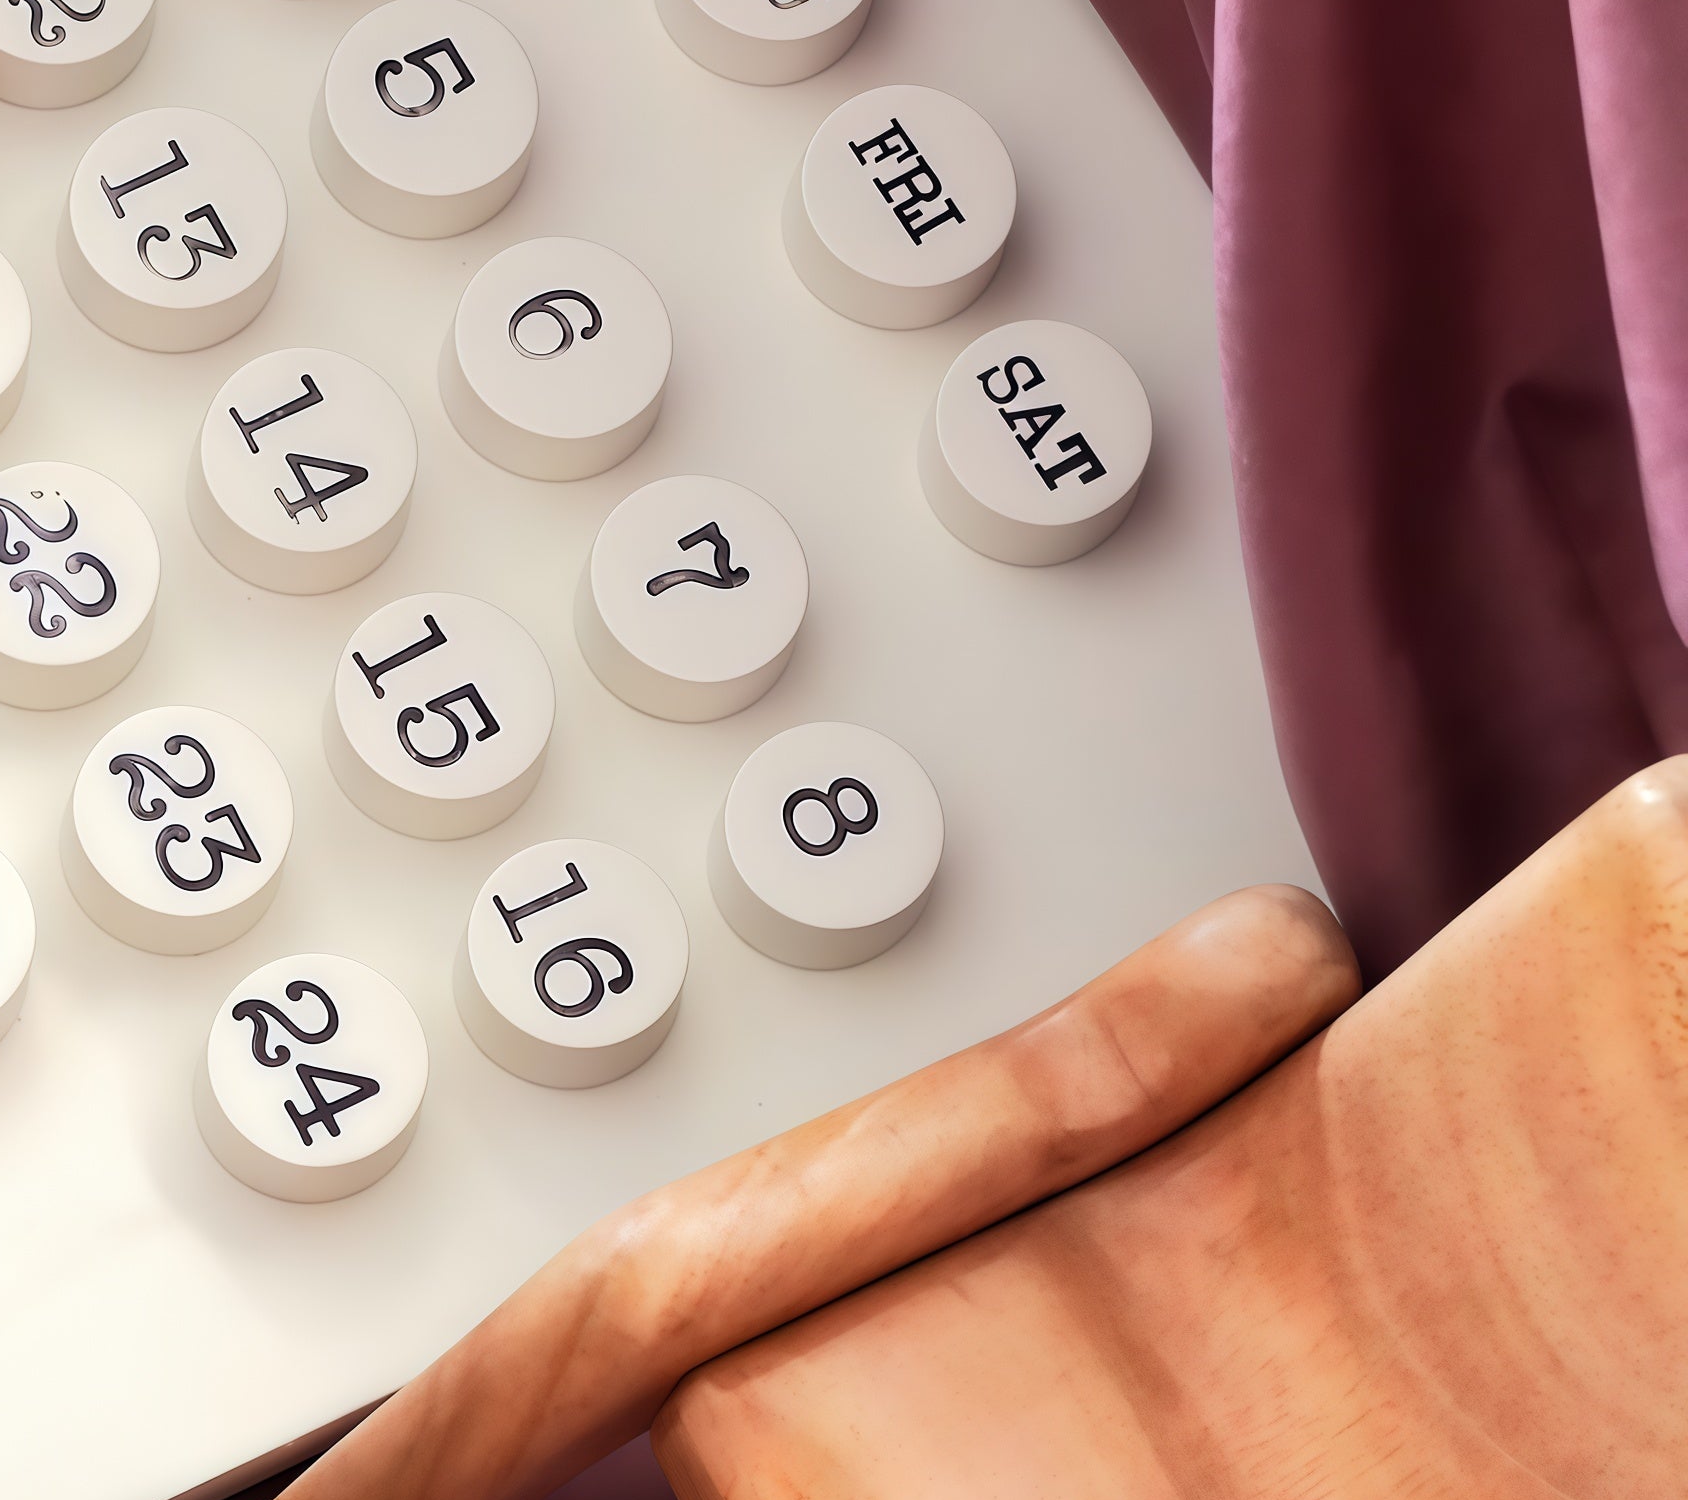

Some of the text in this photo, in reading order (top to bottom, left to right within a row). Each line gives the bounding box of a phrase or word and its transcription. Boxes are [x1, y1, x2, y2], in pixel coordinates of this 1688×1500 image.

[375, 38, 475, 117] 5
[100, 140, 237, 281] 13
[848, 118, 966, 246] FRI
[509, 290, 602, 360] 6
[229, 374, 368, 524] 14
[977, 356, 1107, 491] SAT
[646, 521, 750, 596] 7
[352, 614, 500, 768] 15
[109, 735, 262, 893] 23
[783, 777, 878, 856] 8
[493, 862, 633, 1018] 16
[232, 980, 380, 1146] 24
